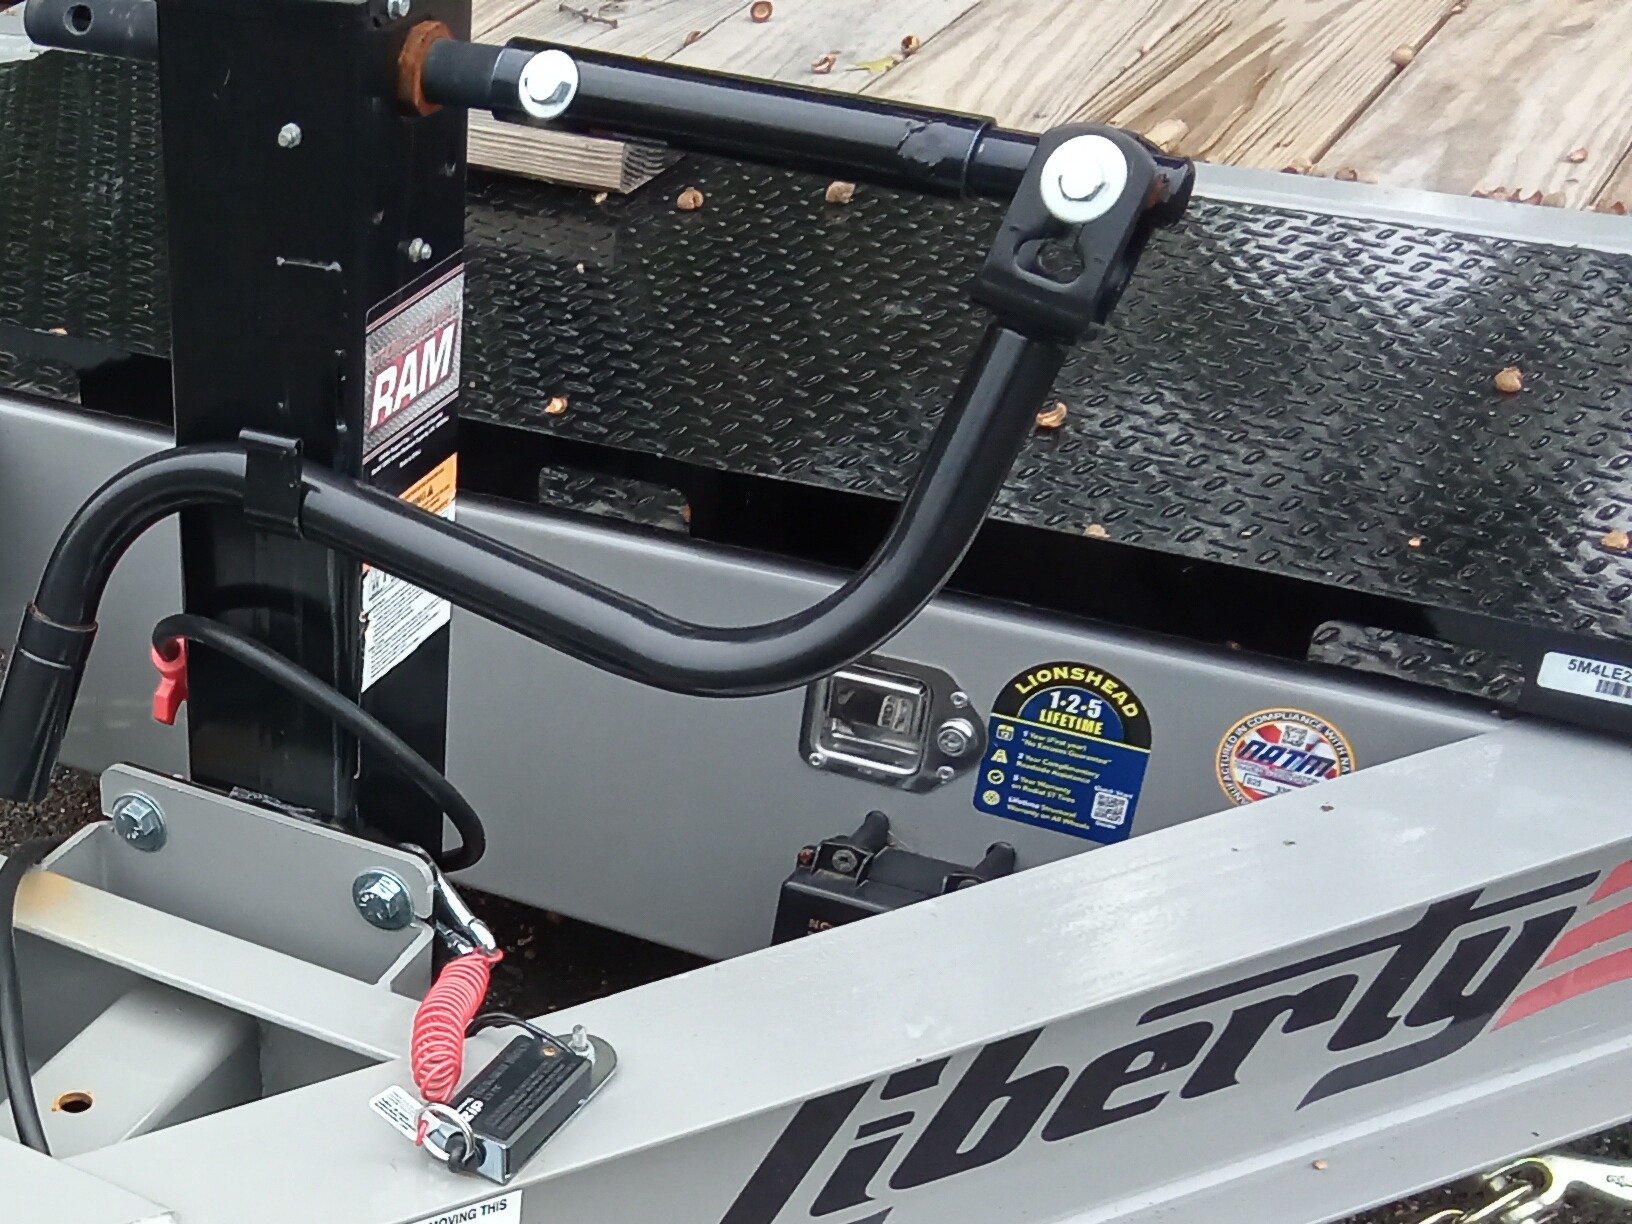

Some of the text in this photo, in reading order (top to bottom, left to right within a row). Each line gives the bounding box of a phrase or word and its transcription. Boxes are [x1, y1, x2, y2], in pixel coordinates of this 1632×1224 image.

[370, 322, 456, 429] RAM
[1015, 666, 1139, 718] LIONSHEAD
[1039, 708, 1105, 736] LIFETIME
[1235, 725, 1248, 736] IN
[1246, 711, 1325, 732] COMPLIANCE
[1325, 727, 1348, 757] WITH
[479, 1198, 508, 1216] THIS
